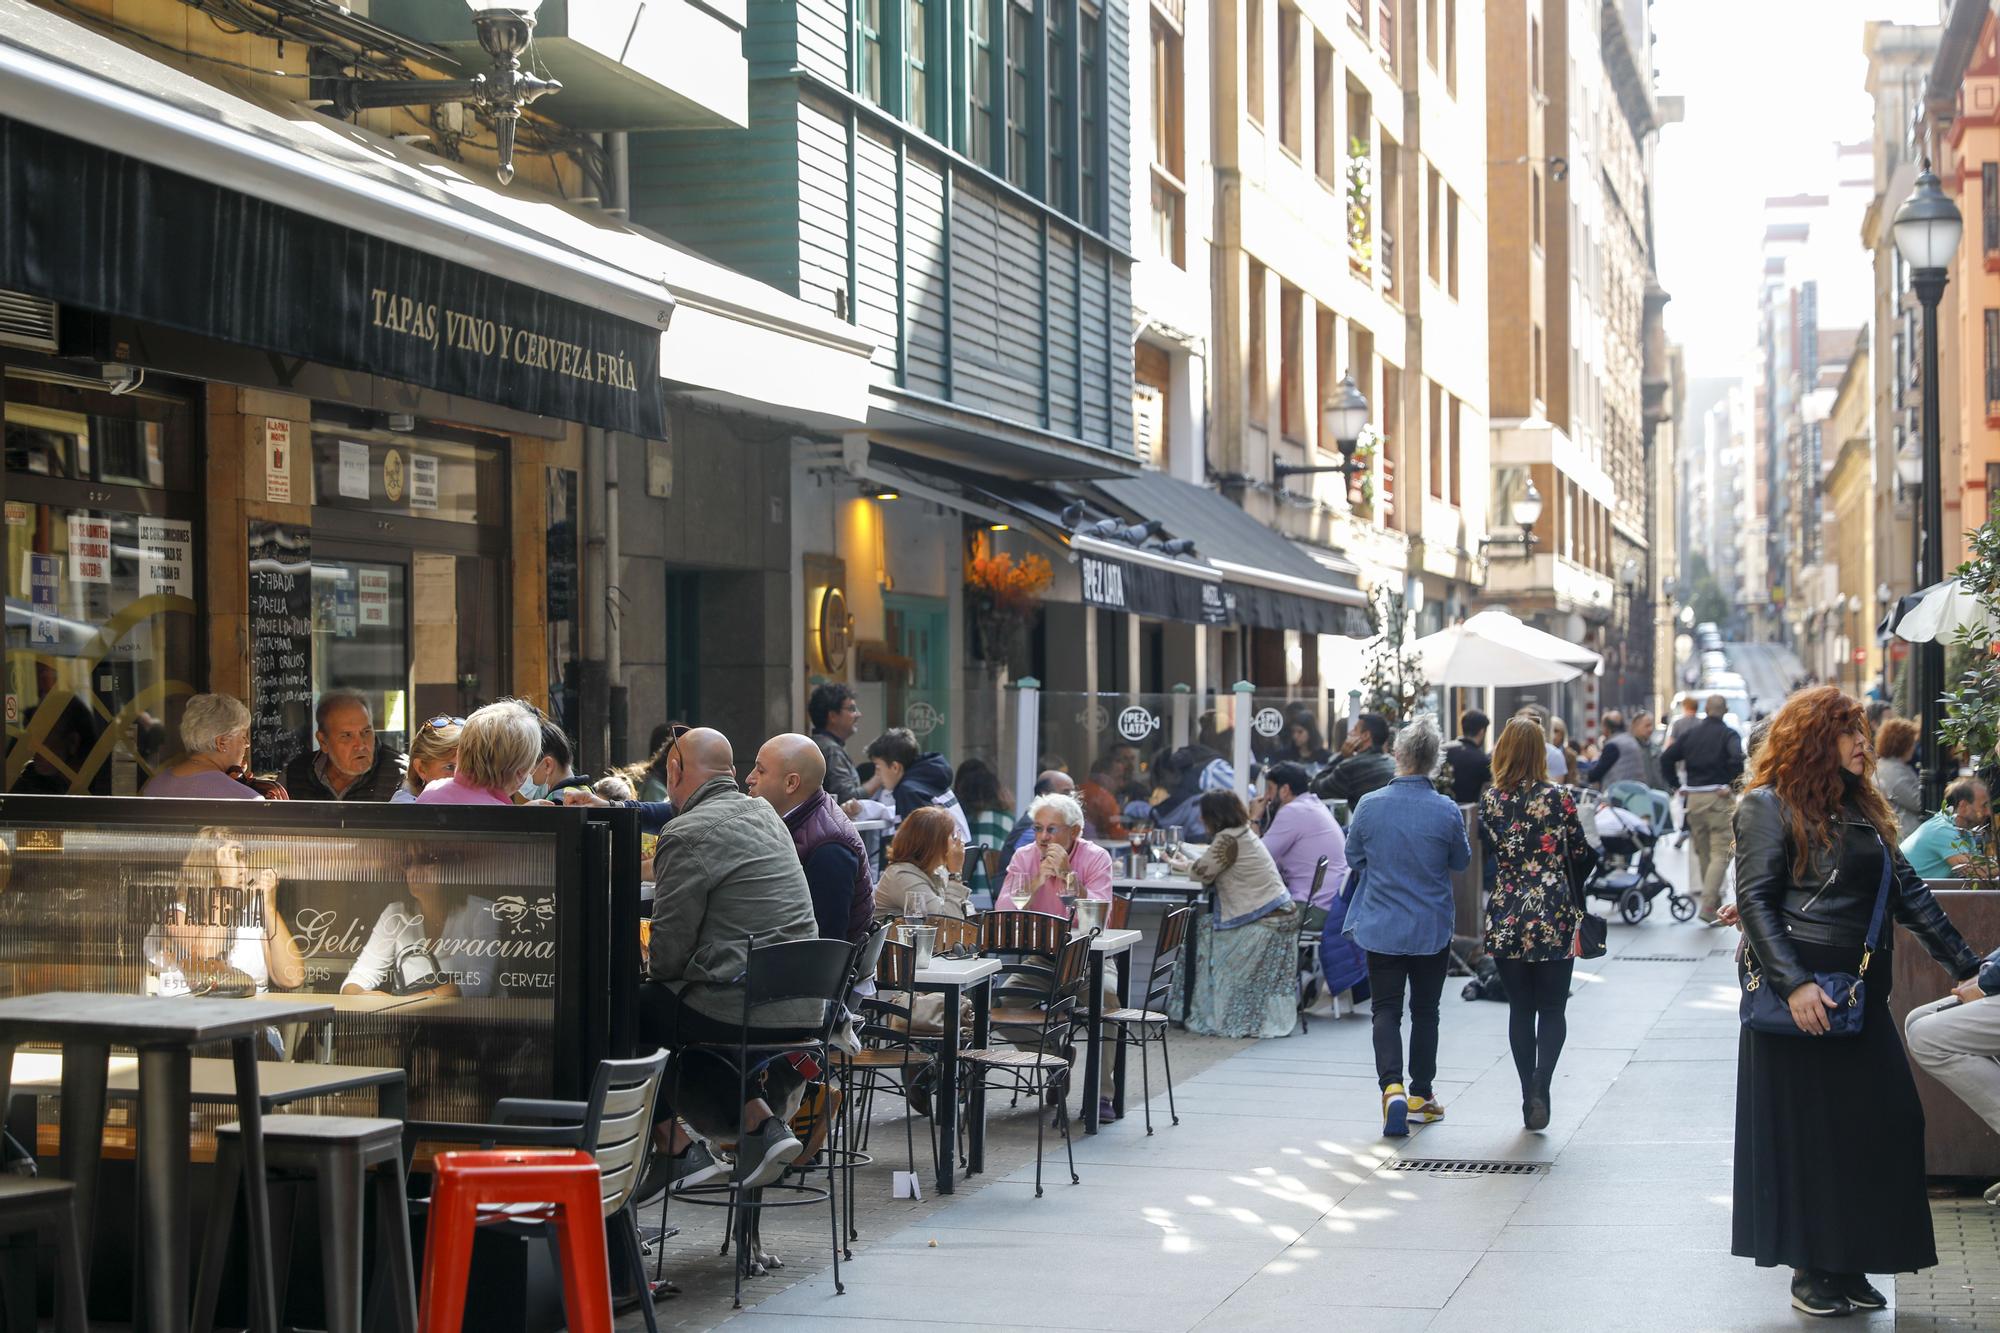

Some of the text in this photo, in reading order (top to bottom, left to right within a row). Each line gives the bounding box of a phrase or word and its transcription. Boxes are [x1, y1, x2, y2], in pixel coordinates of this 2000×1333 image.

[372, 288, 637, 392] TAPAS, VINO Y CERVEZA FRÍA
[141, 526, 149, 540] LAS
[260, 571, 295, 592] FABADA
[1104, 563, 1125, 606] LATA
[1124, 723, 1146, 734] LATA
[185, 878, 266, 928] ALEGRÍA
[287, 907, 365, 960] Geli
[283, 965, 331, 982] COPAS
[415, 970, 481, 986] COCTELES
